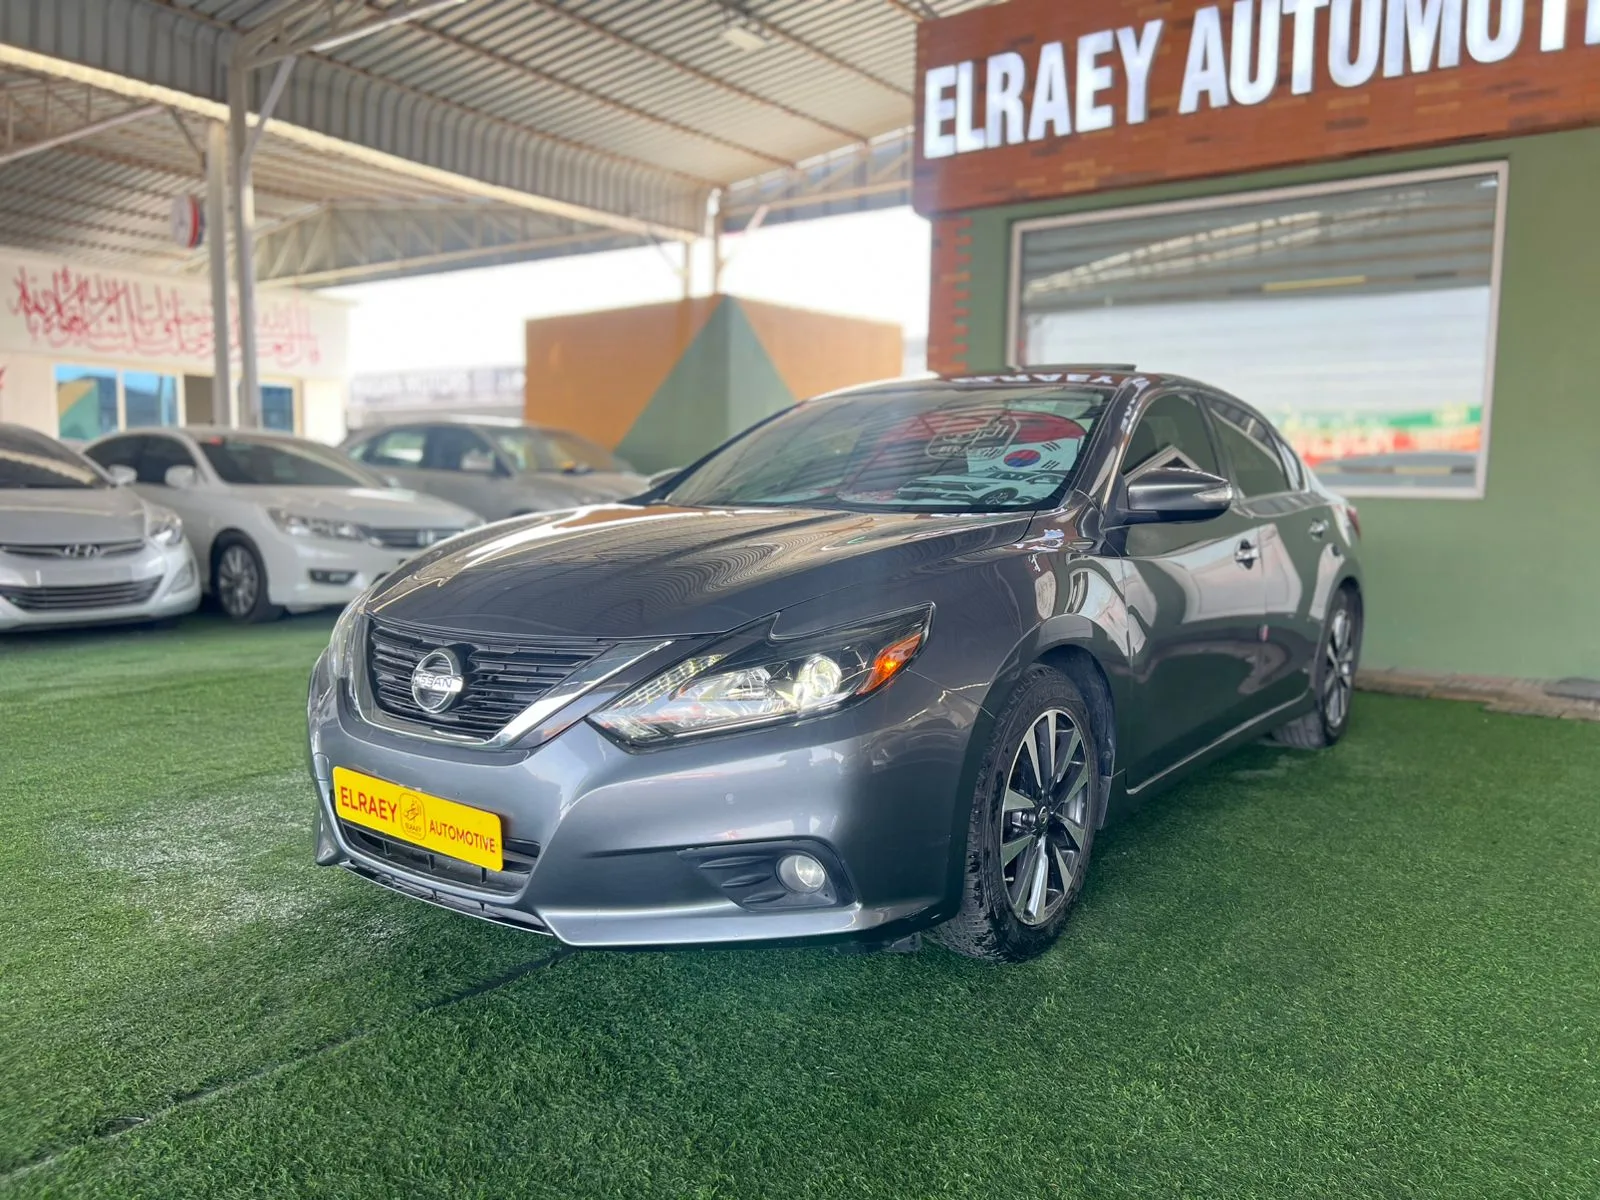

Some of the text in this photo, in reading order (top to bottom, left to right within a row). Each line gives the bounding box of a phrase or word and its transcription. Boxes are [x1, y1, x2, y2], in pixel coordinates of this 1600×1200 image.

[923, 19, 1163, 159] ELRAEY
[414, 675, 453, 689] ISSAN
[340, 786, 397, 823] ELRAEY
[429, 819, 496, 853] AUTOMOTIVE
